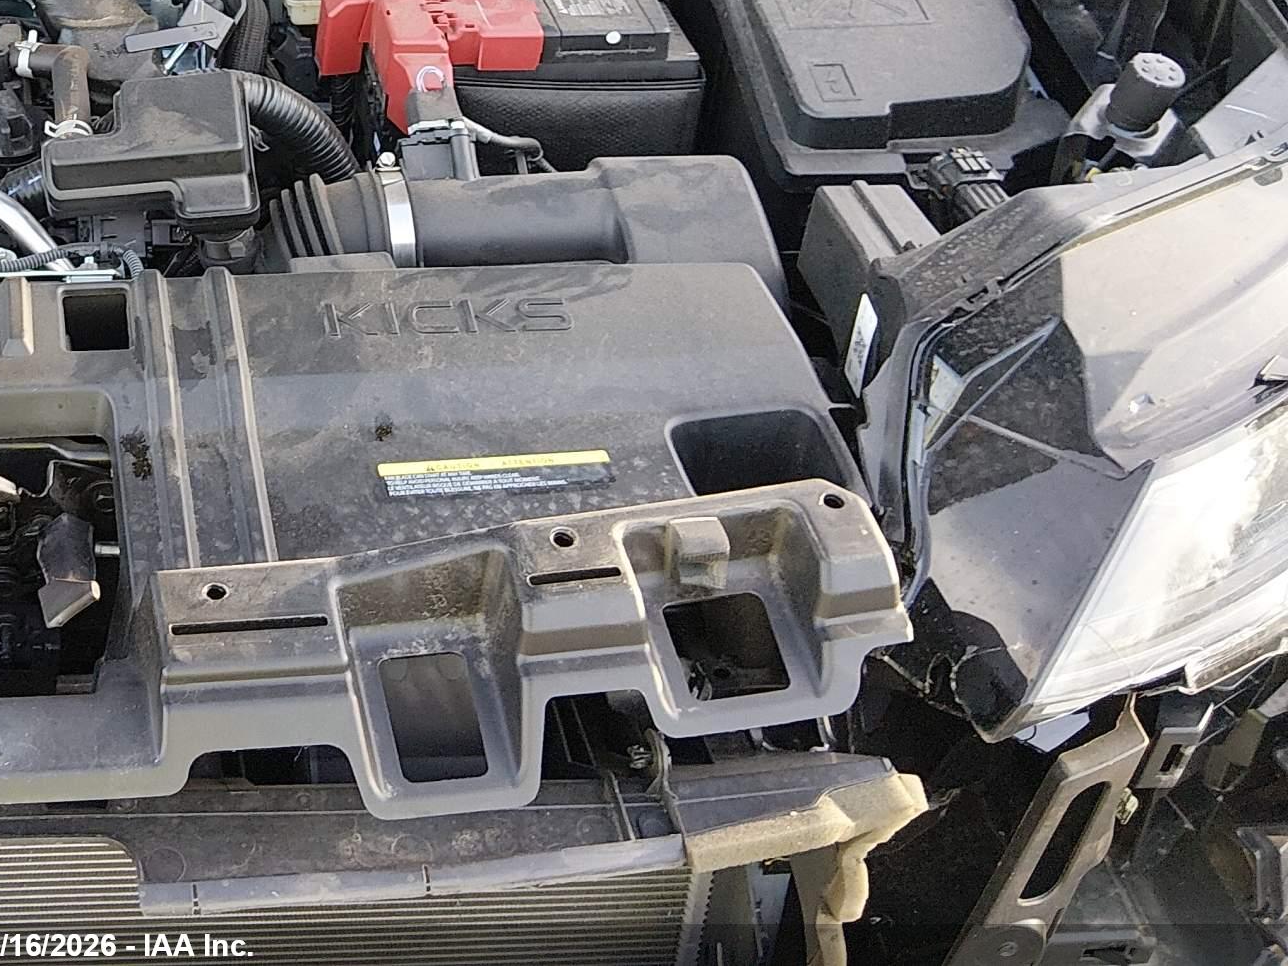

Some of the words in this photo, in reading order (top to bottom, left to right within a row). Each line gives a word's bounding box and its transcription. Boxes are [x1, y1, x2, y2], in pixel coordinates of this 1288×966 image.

[320, 298, 575, 337] KICKS
[436, 462, 481, 470] CAUTION
[502, 457, 555, 466] ATTENTION
